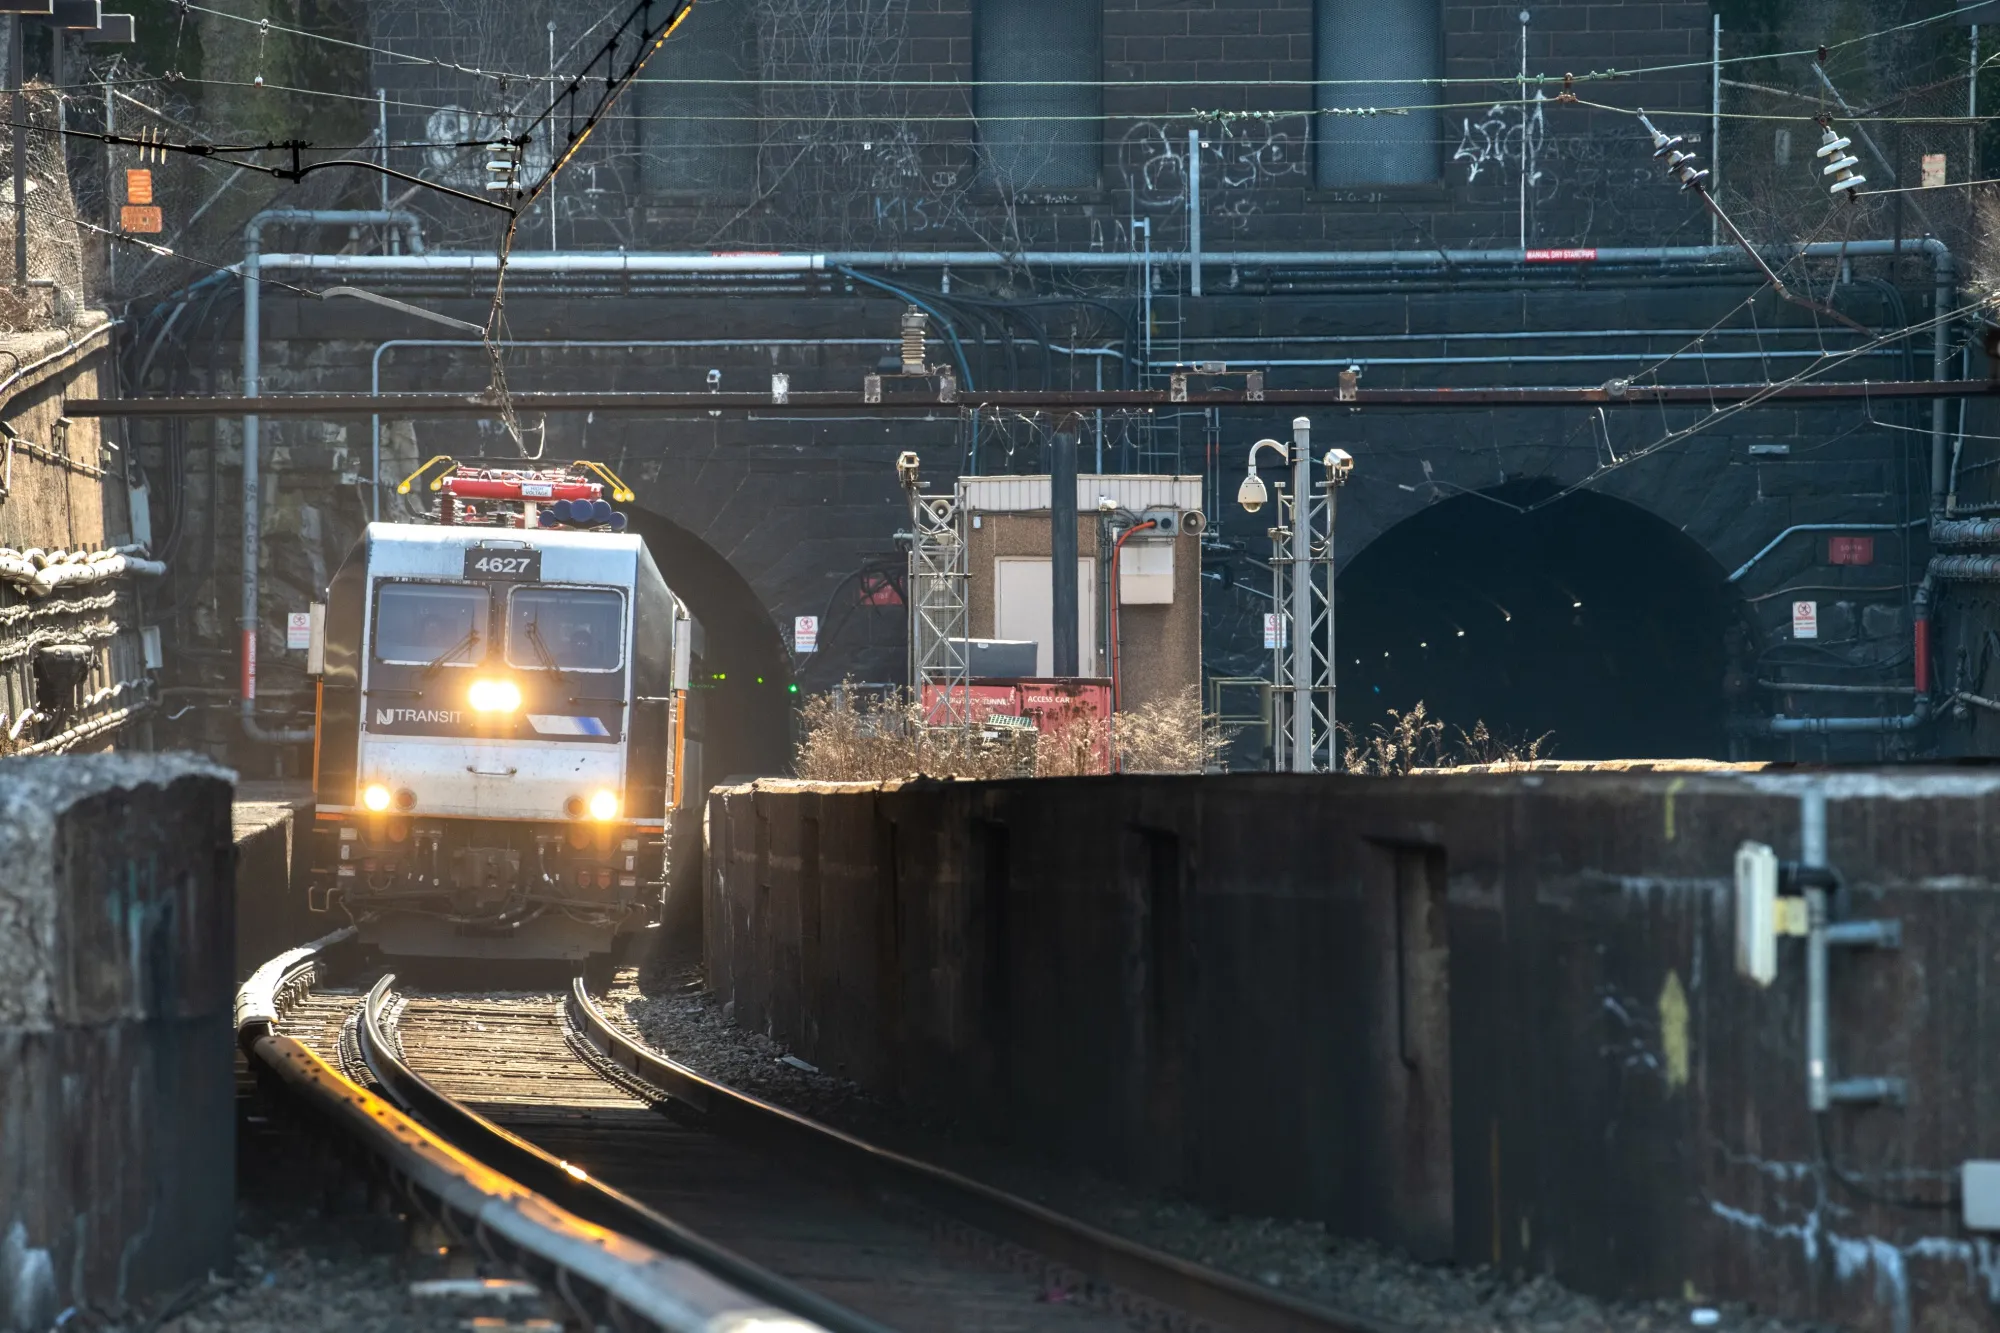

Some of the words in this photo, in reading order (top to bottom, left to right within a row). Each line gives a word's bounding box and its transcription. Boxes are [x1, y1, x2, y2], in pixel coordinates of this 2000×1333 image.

[475, 557, 531, 573] 4627
[376, 708, 394, 725] NJ
[395, 709, 463, 724] TRANSIT
